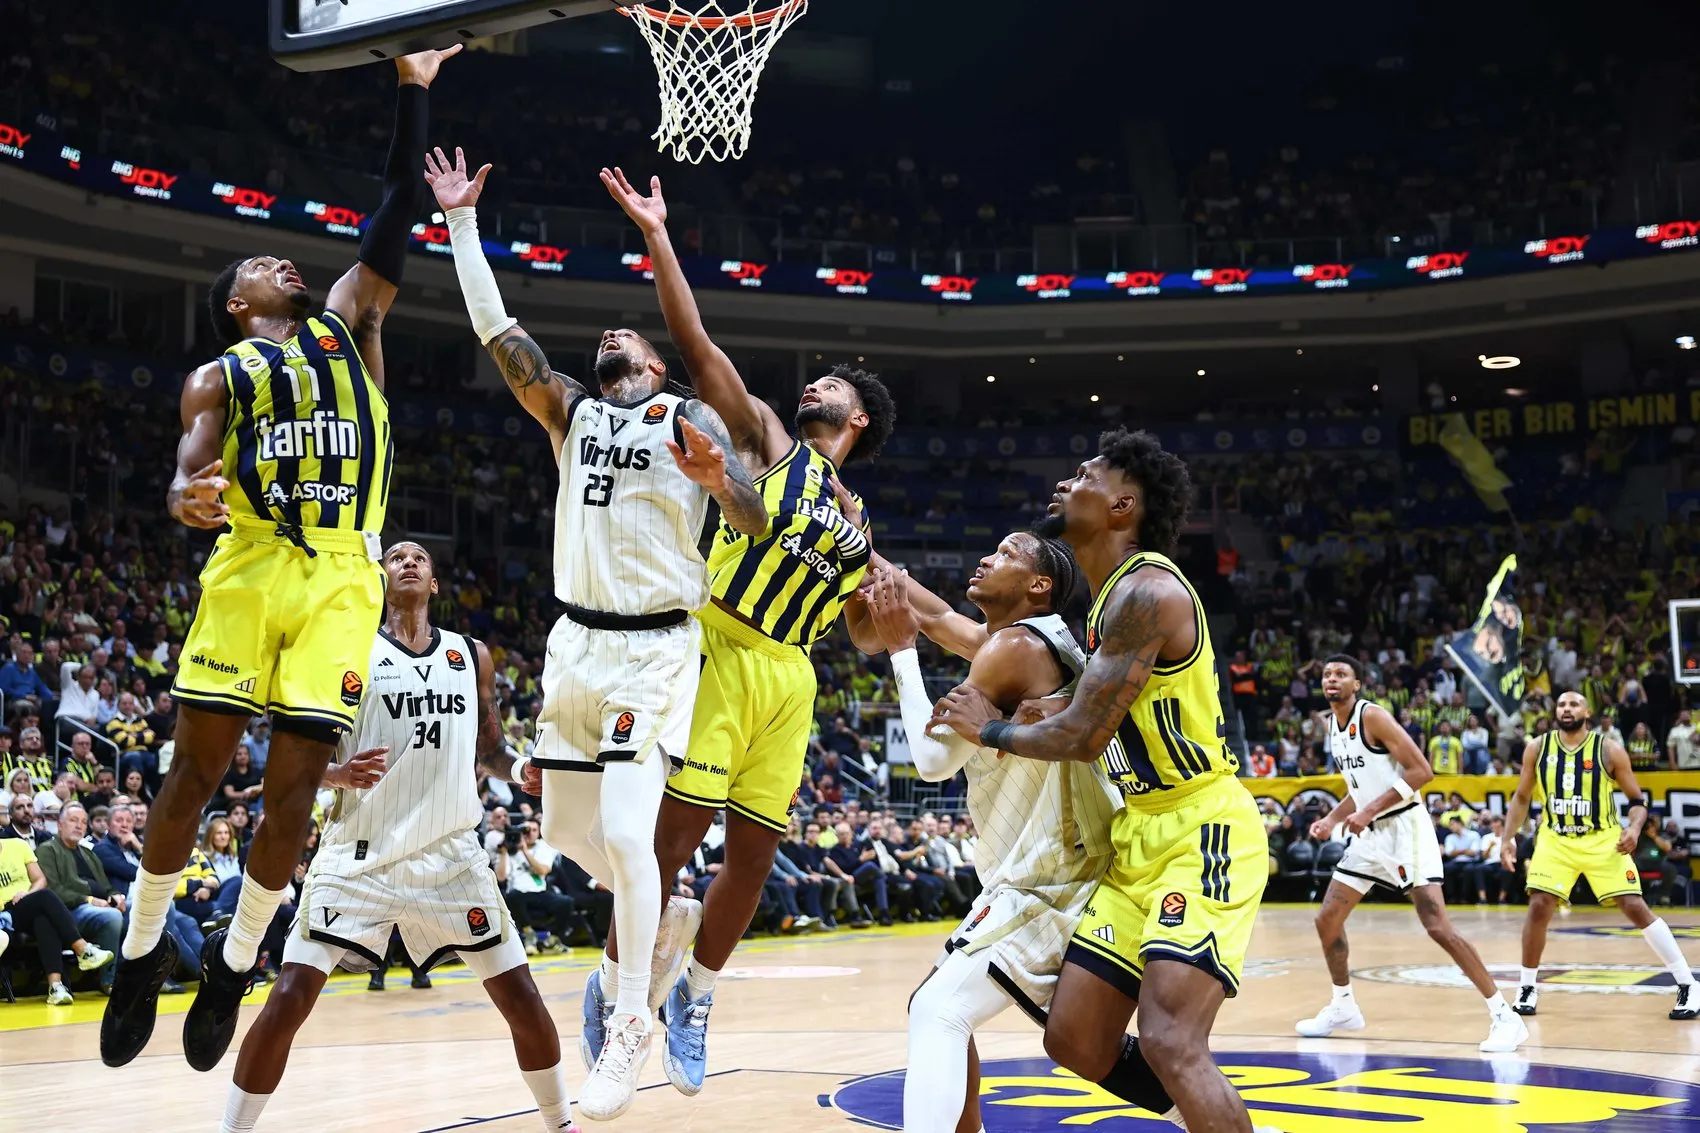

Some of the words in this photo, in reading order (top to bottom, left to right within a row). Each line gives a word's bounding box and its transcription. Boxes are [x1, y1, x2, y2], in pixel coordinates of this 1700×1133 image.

[0, 123, 31, 148] OY
[121, 167, 178, 190] JOY
[134, 185, 171, 200] sports
[221, 188, 277, 209] JOY
[314, 206, 366, 227] JOY
[1647, 220, 1700, 243] JOY
[519, 245, 571, 262] JOY
[1534, 234, 1591, 257] JOY
[1302, 264, 1354, 281] JOY
[1415, 251, 1469, 273] JOY
[824, 270, 874, 285] JOY
[929, 276, 978, 291] JOY
[1026, 273, 1077, 291] JOY
[1115, 271, 1167, 288] JOY
[1200, 268, 1253, 286] JOY
[281, 364, 321, 403] 11
[259, 410, 357, 459] tarfin
[583, 473, 615, 507] 23
[207, 658, 239, 675] Hotels
[381, 689, 466, 719] Virtus
[413, 720, 441, 749] 34
[683, 756, 708, 772] Limak
[1562, 772, 1575, 791] 8
[1549, 793, 1591, 816] tarfin
